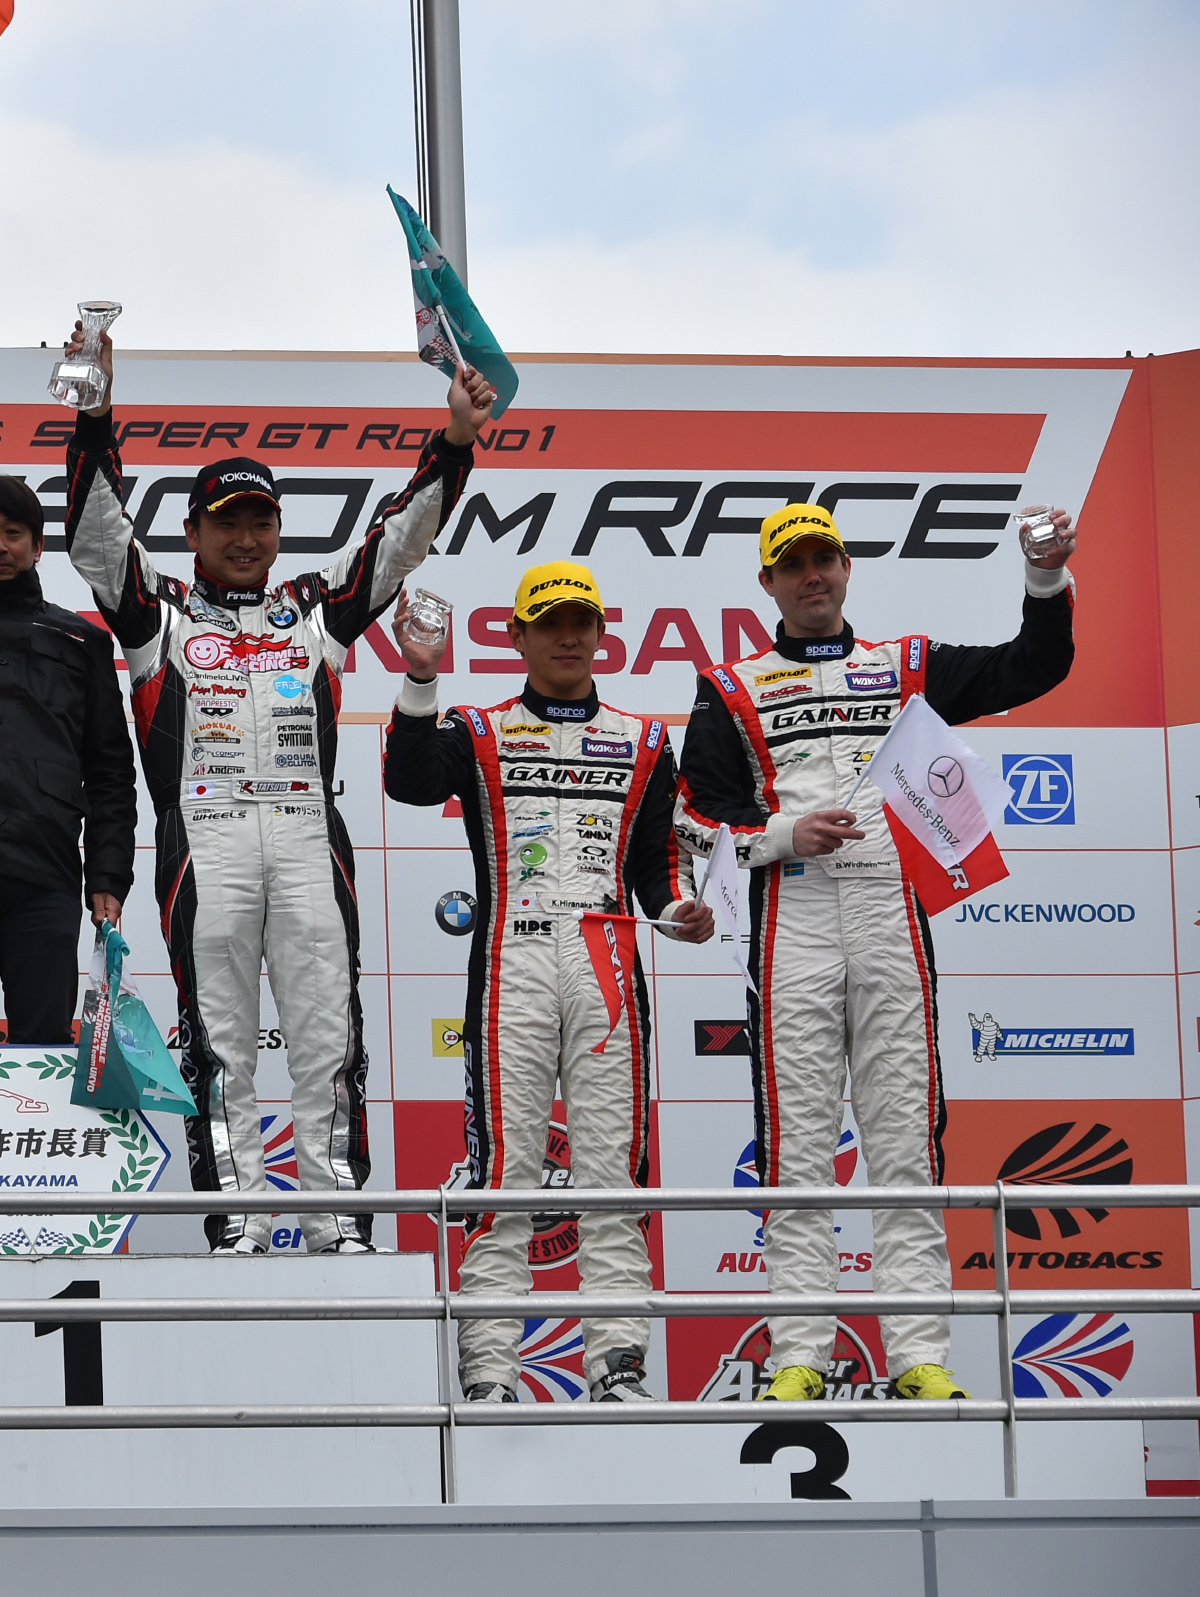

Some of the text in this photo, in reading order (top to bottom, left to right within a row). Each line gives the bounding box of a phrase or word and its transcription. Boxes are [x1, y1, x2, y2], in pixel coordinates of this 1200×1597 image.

[257, 423, 349, 449] GT
[540, 425, 556, 451] 1
[219, 471, 273, 492] YOKOHAMA
[768, 516, 830, 542] DUNLOP
[528, 577, 593, 598] DUNLOP
[805, 643, 843, 656] sparco
[223, 658, 292, 675] RACING
[713, 668, 736, 693] sparco
[764, 668, 809, 682] DUNLOP
[196, 699, 238, 707] BANPRESTO
[547, 706, 587, 718] sparco
[772, 705, 892, 730] GAINER
[277, 724, 313, 732] PETRONAS
[465, 708, 487, 736] sparco
[504, 725, 549, 735] DUNLOP
[646, 720, 664, 750] sparco
[278, 733, 314, 748] SYNTIUM
[287, 753, 316, 761] OGURA
[287, 760, 317, 768] CLUTCH
[506, 766, 629, 787] GAINER
[1018, 771, 1058, 803] ZF
[889, 761, 962, 849] Mercedes-Benz
[576, 855, 612, 866] OAKLEY
[835, 861, 878, 870] B.Wirdheim
[551, 899, 593, 909] K.Hiranaka
[513, 920, 553, 932] HDC
[1004, 1033, 1129, 1048] MICHELIN
[960, 1250, 1164, 1270] AUTOBACS
